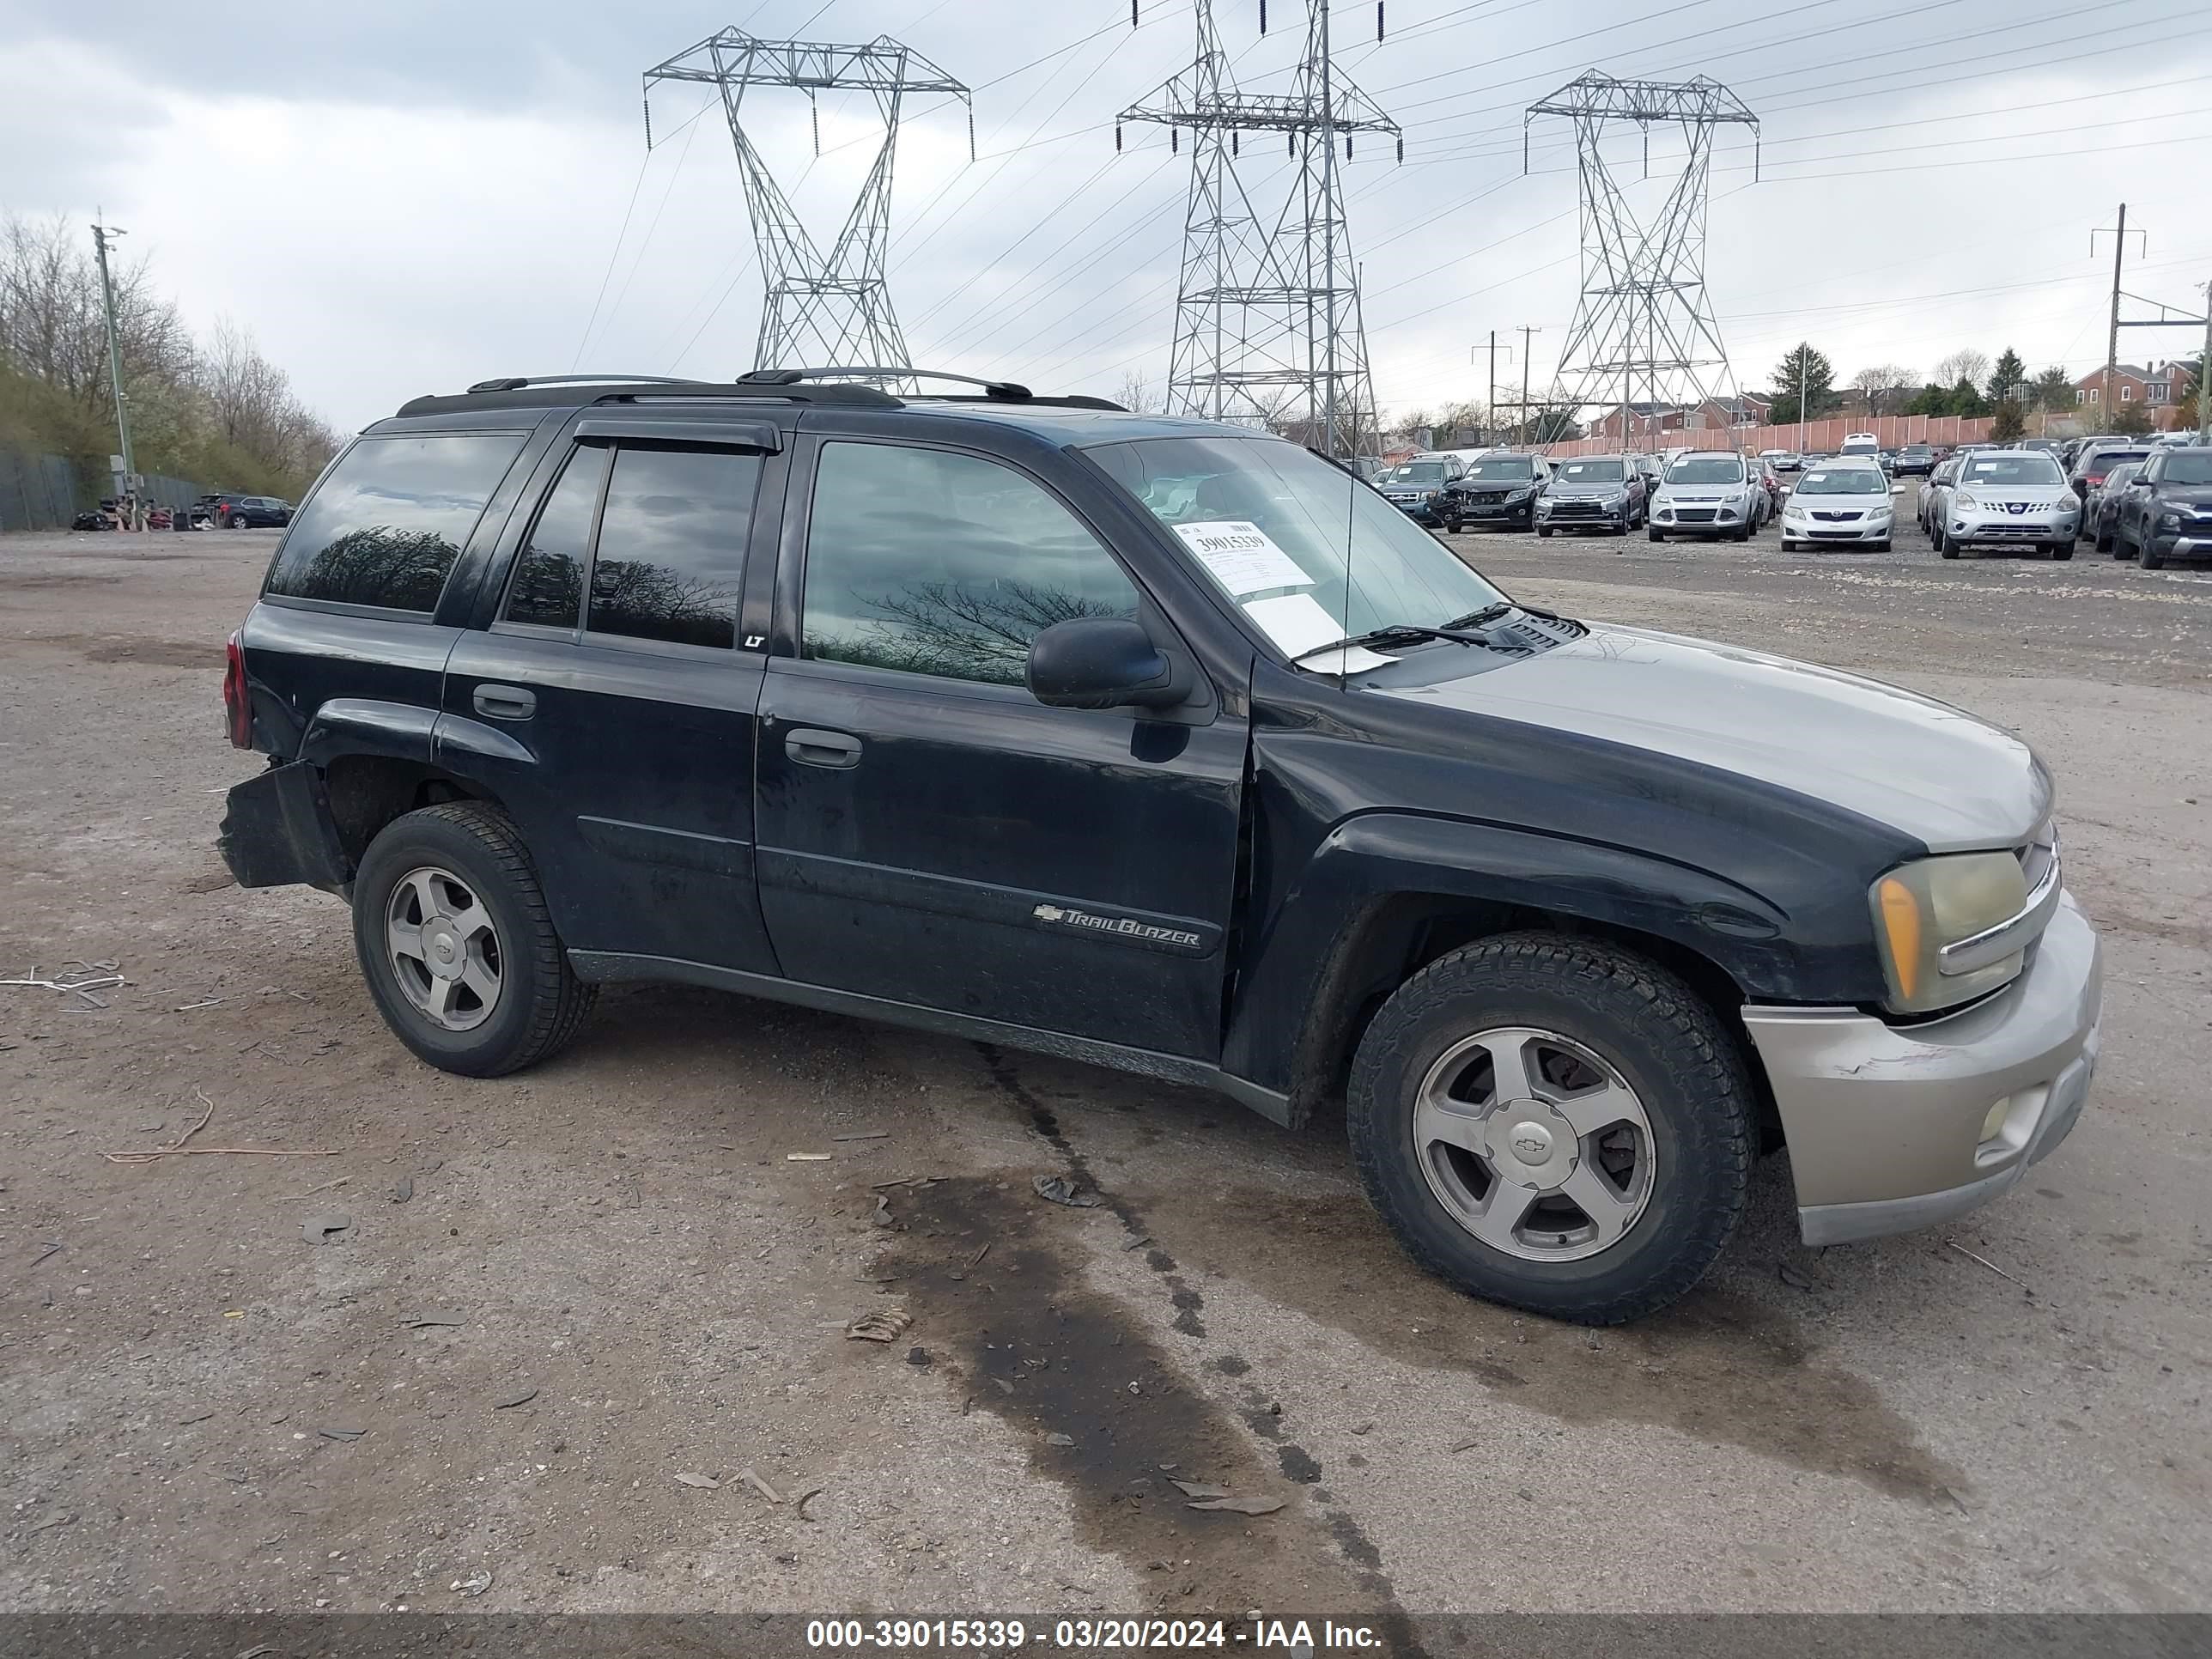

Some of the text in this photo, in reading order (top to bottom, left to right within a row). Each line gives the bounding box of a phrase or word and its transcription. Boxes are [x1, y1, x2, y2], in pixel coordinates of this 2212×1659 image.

[1196, 536, 1265, 552] 39015339
[744, 635, 766, 648] LT
[1064, 908, 1200, 946] TRAILBLAZER
